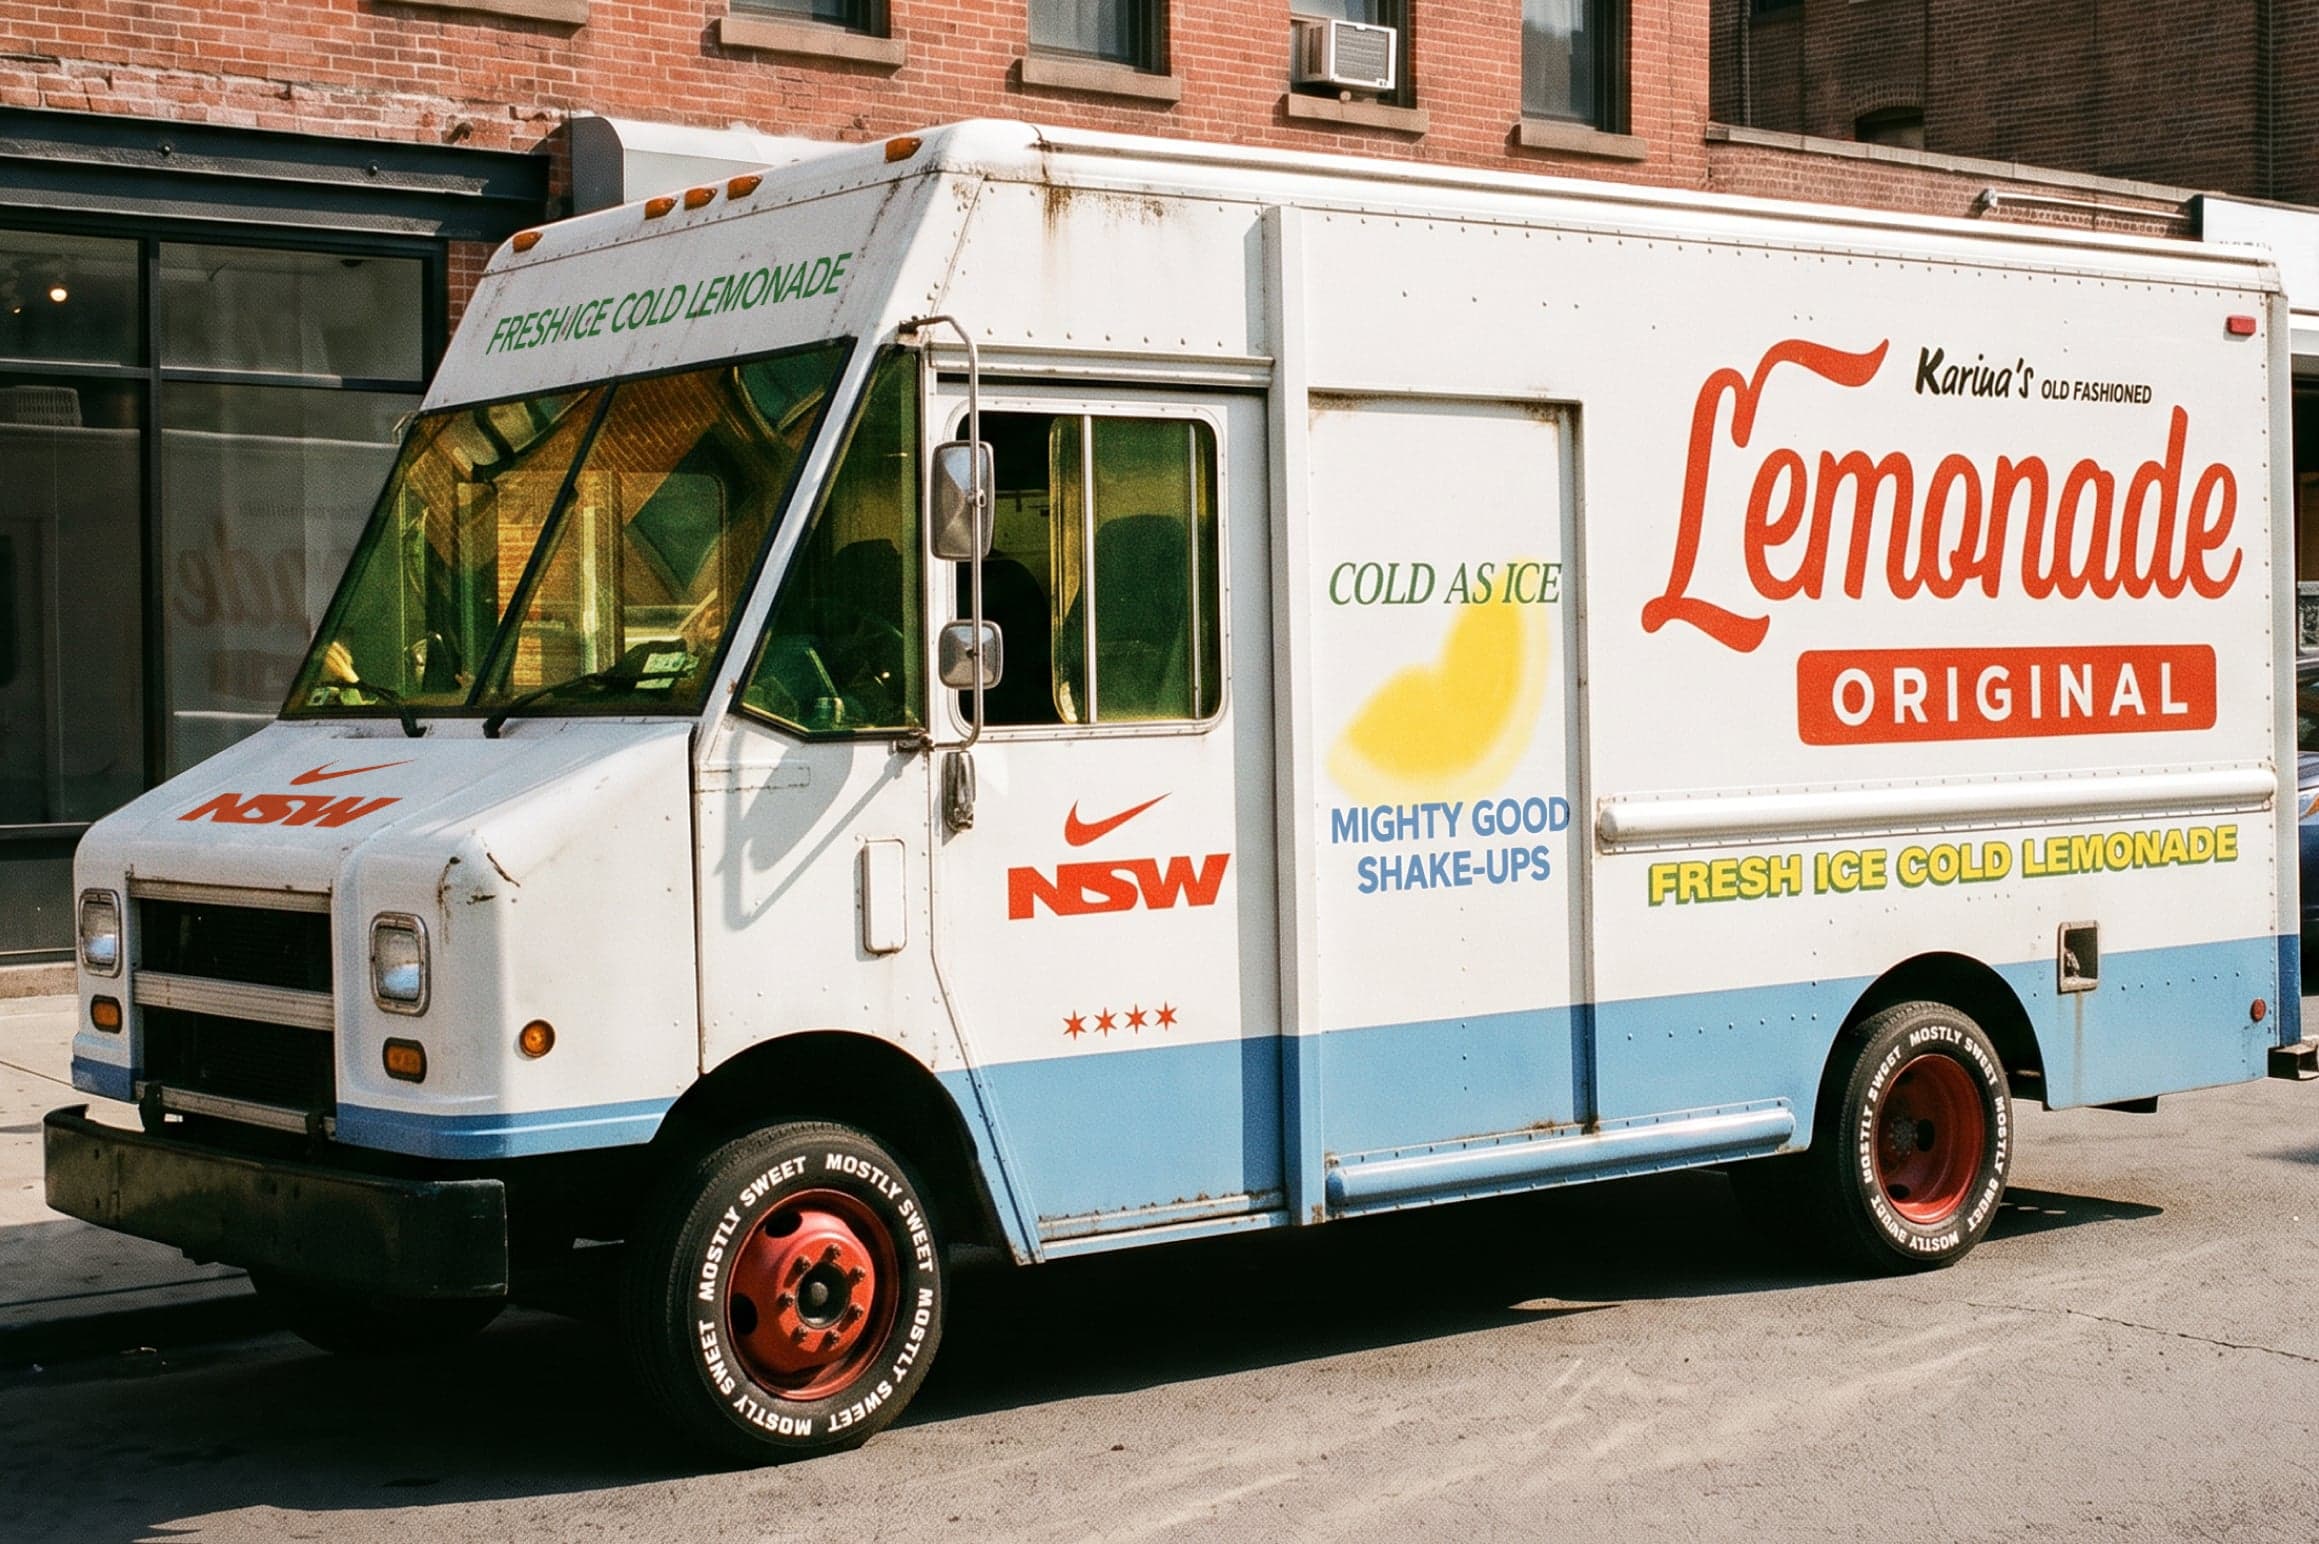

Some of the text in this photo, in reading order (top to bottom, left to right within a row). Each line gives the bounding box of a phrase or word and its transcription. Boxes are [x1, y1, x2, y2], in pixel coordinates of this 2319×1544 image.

[486, 252, 853, 355] FRESH ICE COLD LEMONADE
[2041, 379, 2069, 400] OLD
[2073, 381, 2152, 404] FASHIONED
[1642, 338, 2243, 653] Lemonade
[1329, 562, 1563, 605] COLD AS ICE
[1831, 660, 2190, 727] ORIGINAL
[177, 793, 402, 828] NSW
[1331, 796, 1571, 844] MIGHTY GOOD
[1007, 853, 1232, 920] NSW
[1357, 845, 1551, 894] SHAKE-UPS
[1648, 824, 2239, 907] FRESH ICE COLD LEMONADE
[1909, 1026, 1963, 1049] MOSTLY
[698, 1155, 808, 1301] MOSTLY SWEET
[825, 1153, 934, 1273] MOSTLY SWEET
[1909, 1230, 1960, 1252] MOSTLY
[698, 1320, 813, 1437] MOSTLY SWEET
[827, 1287, 934, 1433] MOSTLY SWEET
